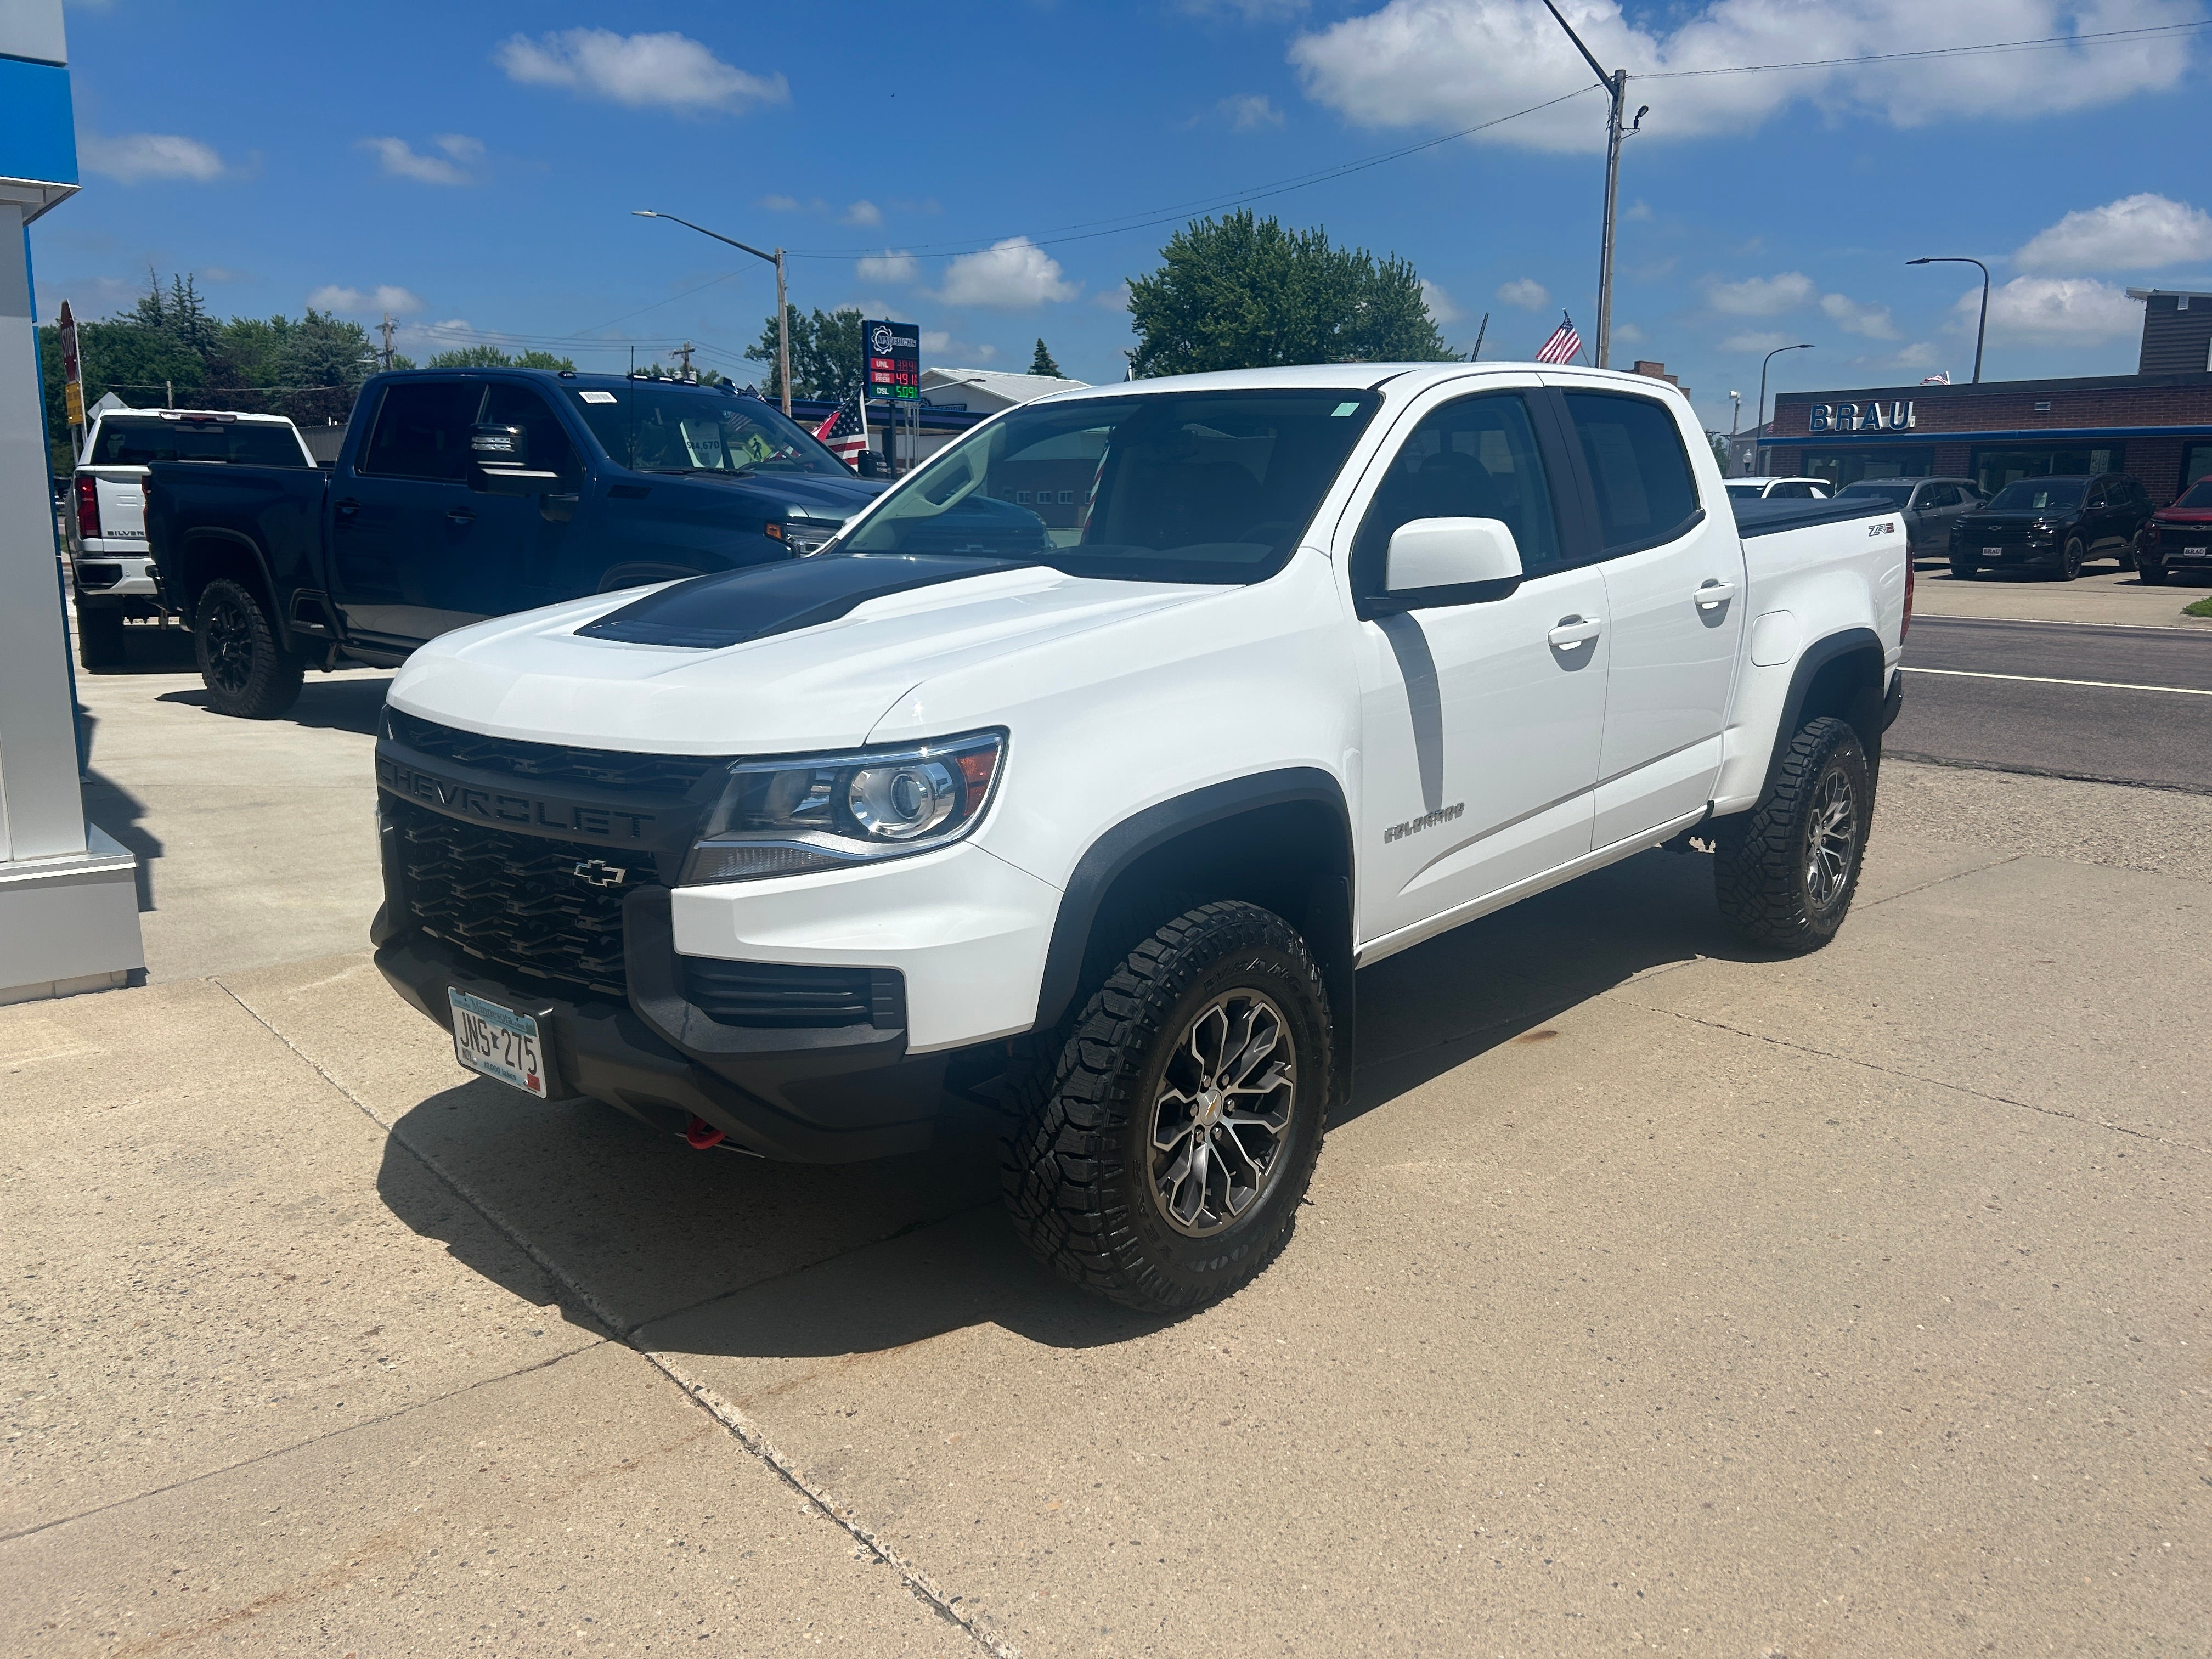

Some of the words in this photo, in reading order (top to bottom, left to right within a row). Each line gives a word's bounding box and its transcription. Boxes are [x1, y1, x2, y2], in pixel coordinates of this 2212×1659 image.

[61, 326, 75, 358] STOP
[1809, 401, 1914, 432] BRAU
[1868, 522, 1894, 537] ZR2
[379, 759, 656, 838] CHEVROLET
[1384, 802, 1465, 844] COLORADO
[460, 1011, 490, 1057] JNS
[501, 1028, 537, 1075] 275
[501, 1070, 516, 1080] lakes
